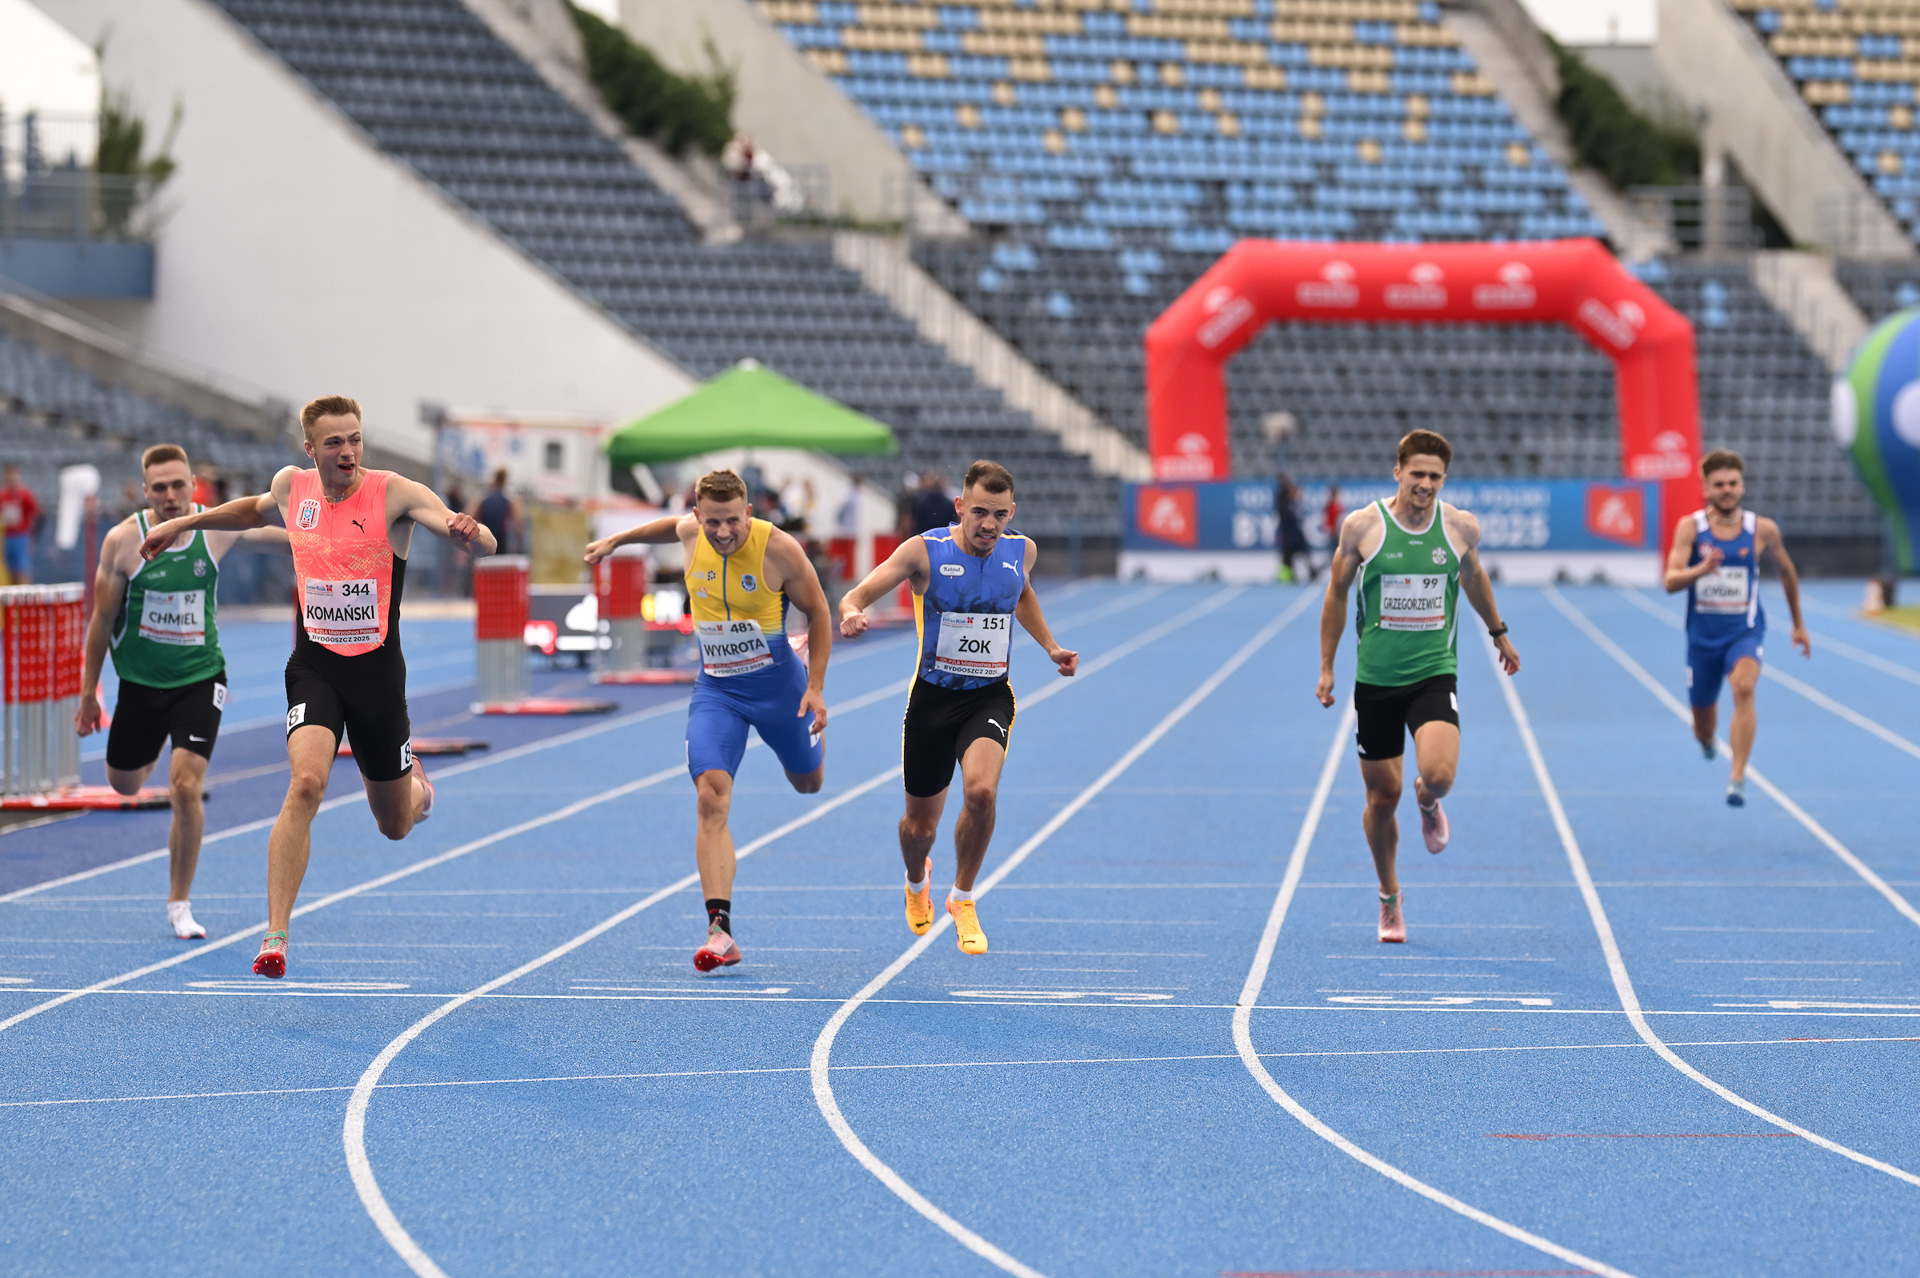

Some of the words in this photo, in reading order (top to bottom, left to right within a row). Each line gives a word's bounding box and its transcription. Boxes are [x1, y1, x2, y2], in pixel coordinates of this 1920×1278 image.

[342, 583, 370, 596] 344
[1423, 578, 1438, 589] 99
[184, 592, 197, 604] 92
[1383, 595, 1442, 610] GRZEGORZEWICZ
[149, 611, 198, 626] CHMIEL
[306, 604, 375, 622] KOMAŃSKI
[730, 622, 755, 634] 481
[982, 617, 1005, 630] 151
[312, 634, 352, 643] BYDGOSZCZ
[958, 635, 992, 654] ŻOK
[703, 638, 765, 657] WYKROTA
[944, 665, 983, 675] BYDGOSZCZ
[217, 688, 224, 704] 9
[288, 707, 299, 727] 8
[404, 742, 411, 764] 8
